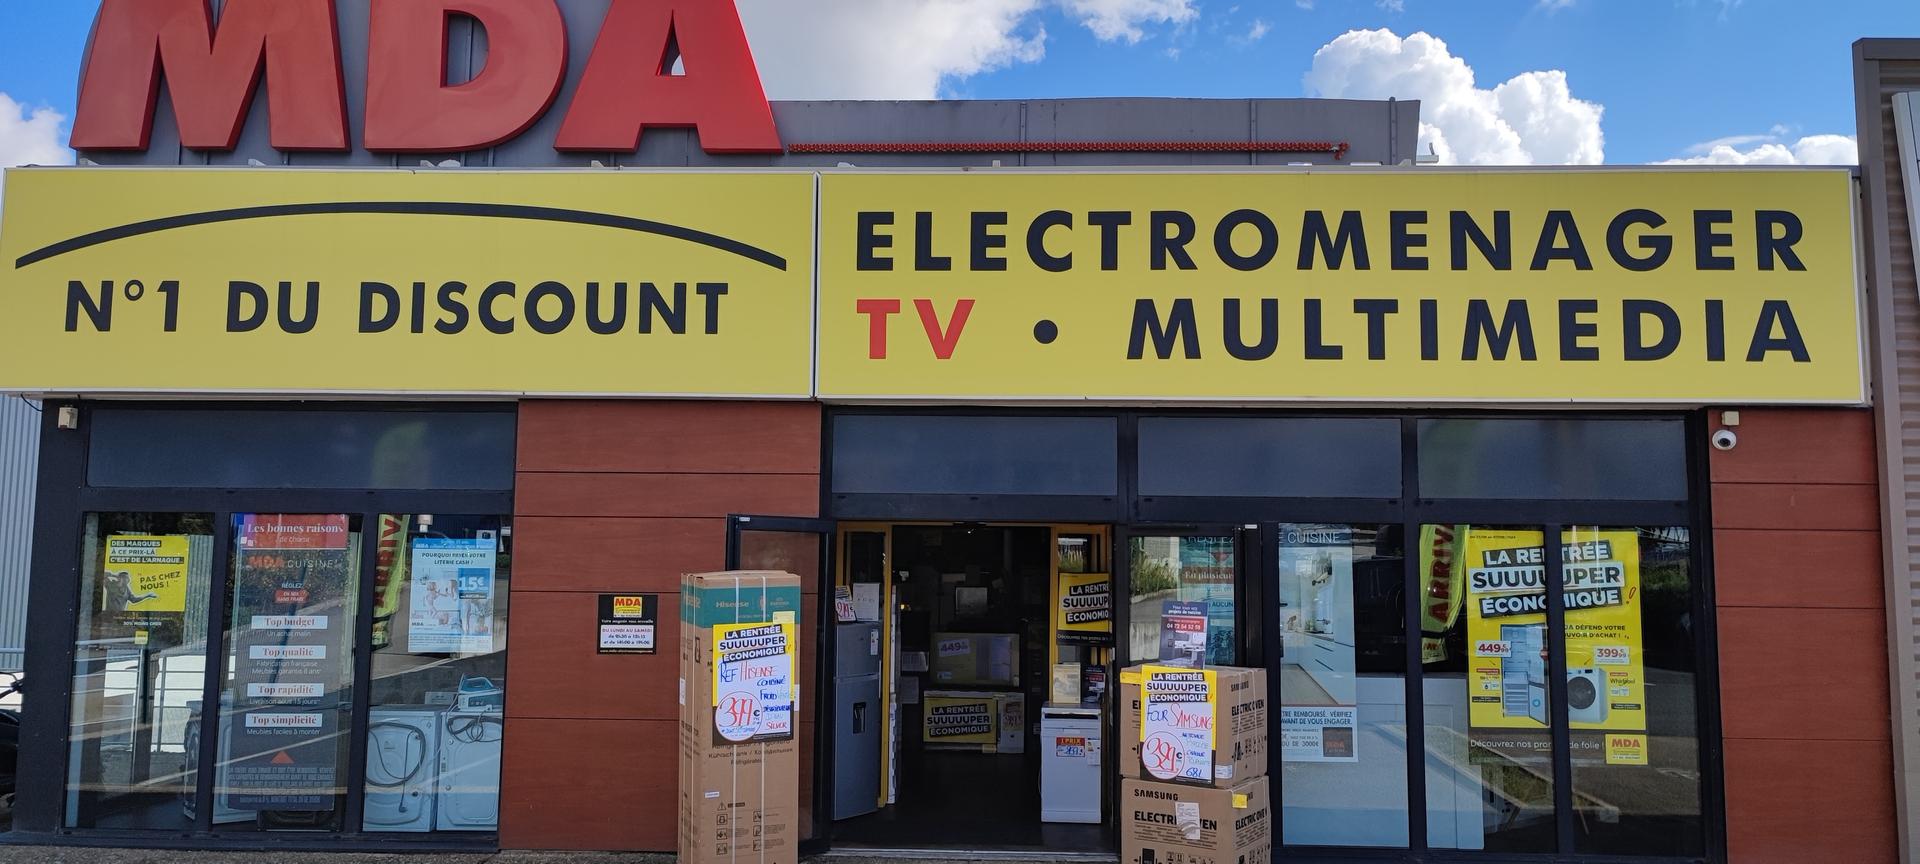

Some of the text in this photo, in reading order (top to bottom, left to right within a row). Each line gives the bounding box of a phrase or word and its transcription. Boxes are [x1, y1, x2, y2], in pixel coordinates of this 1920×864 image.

[69, 0, 782, 155] MDA
[856, 209, 1808, 273] ELECTROMENAGER
[64, 279, 729, 336] N°1 DU DISCOUNT
[855, 298, 1812, 363] TV MULTIMEDIA
[248, 523, 343, 533] Les bonnes raisons
[1287, 531, 1340, 544] CUISINE
[126, 540, 160, 548] MARQUES
[1485, 542, 1609, 565] LA RETRÉE
[287, 559, 334, 568] CUISINE
[140, 571, 181, 584] PAS CHEZ
[1428, 524, 1454, 624] ARRIV
[140, 581, 164, 592] NOUS
[1070, 586, 1083, 595] LA
[615, 598, 641, 606] MDA
[264, 617, 315, 627] Top budget
[1575, 623, 1602, 631] DÉFEND
[725, 625, 781, 639] LA RENTRÉE
[719, 636, 785, 650] SUUUUUPER
[263, 647, 314, 658] Top qualité
[1165, 672, 1203, 681] RENTRÉE
[257, 684, 314, 695] Top rapidité
[1146, 682, 1208, 692] SUUUUUPER
[946, 704, 986, 714] RENTRÉE
[252, 714, 317, 726] Top simplicité
[926, 715, 990, 725] SUUUUUPER
[930, 725, 988, 736] ÉCONOMIQUE
[1470, 739, 1515, 748] Découvrez
[1581, 739, 1600, 749] folie
[1611, 738, 1641, 748] MDA
[1134, 788, 1179, 801] SAMSUNG
[1134, 811, 1177, 825] ELECTRI
